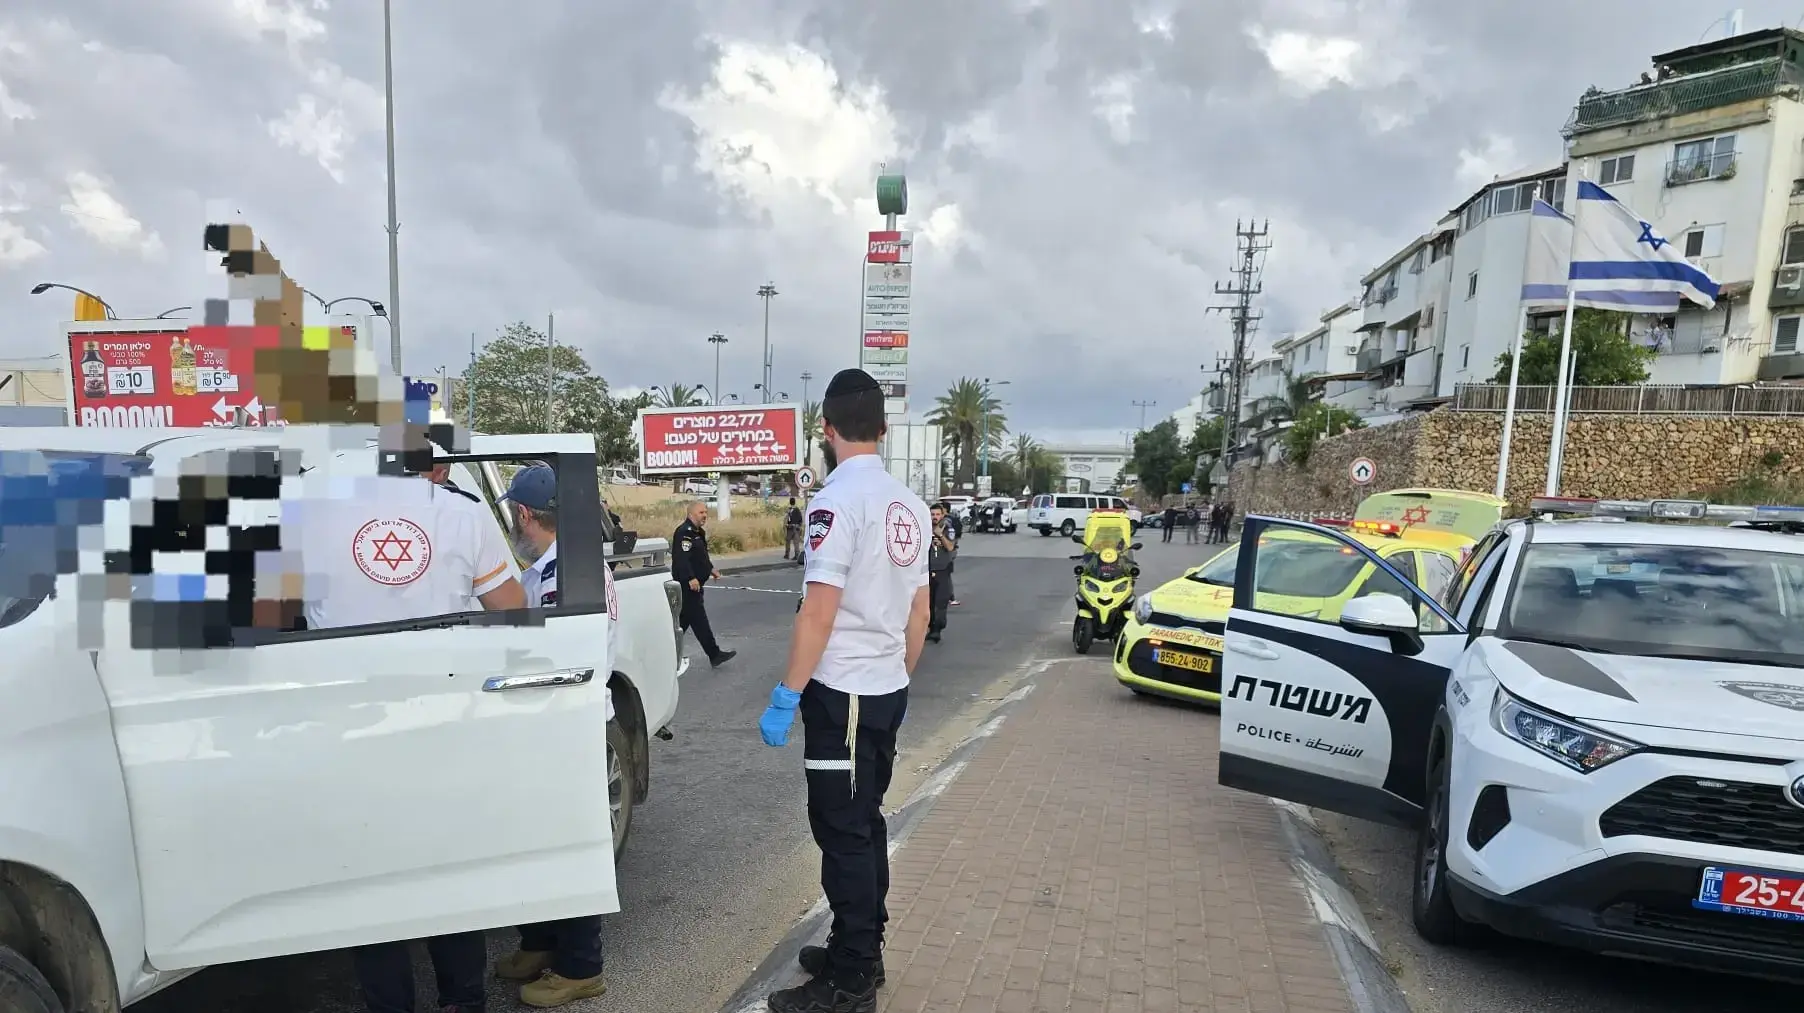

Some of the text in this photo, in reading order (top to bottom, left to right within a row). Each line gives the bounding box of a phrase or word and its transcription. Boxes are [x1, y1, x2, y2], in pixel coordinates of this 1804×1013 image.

[103, 341, 151, 352] סילאן תמרים
[126, 372, 143, 388] 10
[81, 406, 173, 428] BOOOM!
[673, 413, 765, 429] 22,777 מוצרים
[664, 429, 775, 445] במחירים של פעם!
[647, 449, 698, 467] BOOOM!
[712, 455, 736, 465] רמלה
[769, 454, 790, 462] משה
[356, 523, 380, 544] בישראל
[405, 524, 417, 533] דוד
[357, 552, 428, 583] MAGEN DAVID ADOM IN ISRAEL
[1149, 628, 1194, 642] PARAMEDIC
[1227, 674, 1372, 724] משטרת
[1236, 723, 1293, 743] POLICE
[1304, 738, 1364, 758] الشرطة
[1706, 880, 1718, 893] IL
[1735, 907, 1767, 916] בשבילך
[1772, 911, 1789, 919] 100
